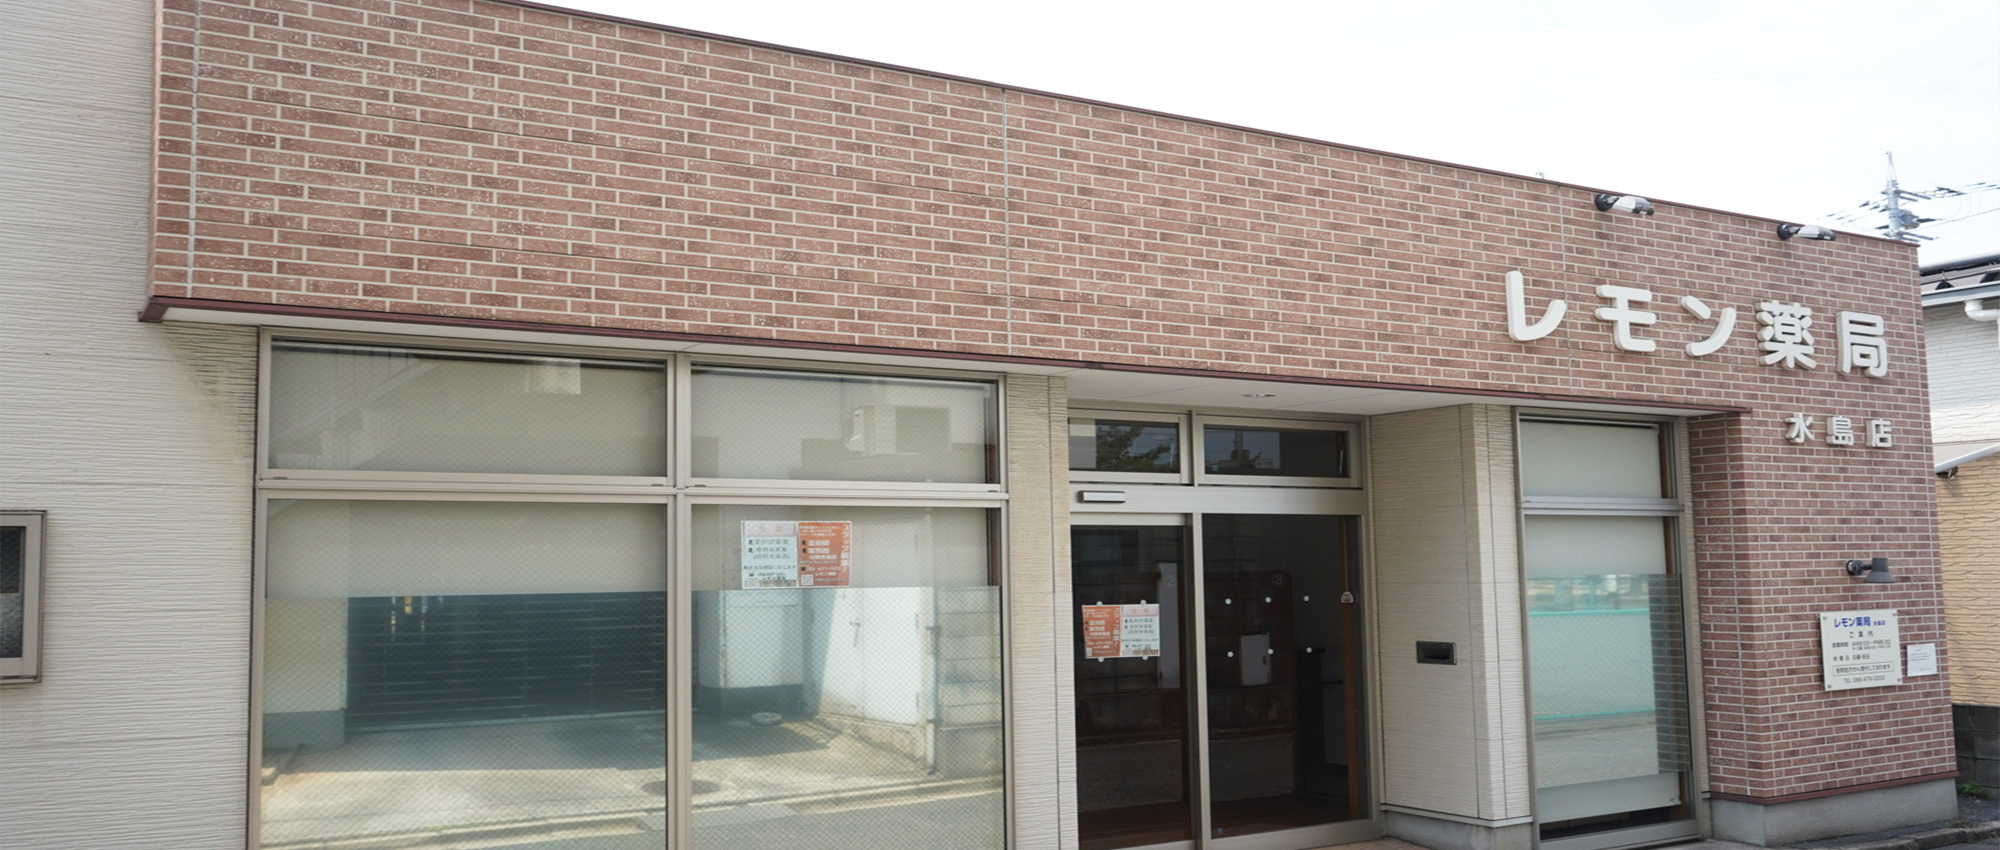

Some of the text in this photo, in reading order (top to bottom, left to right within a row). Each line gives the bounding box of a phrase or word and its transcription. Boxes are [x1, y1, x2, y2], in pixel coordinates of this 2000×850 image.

[1505, 270, 1888, 378] レモン薬局
[1784, 412, 1892, 448] 水島店
[1834, 616, 1871, 627] レモン薬局
